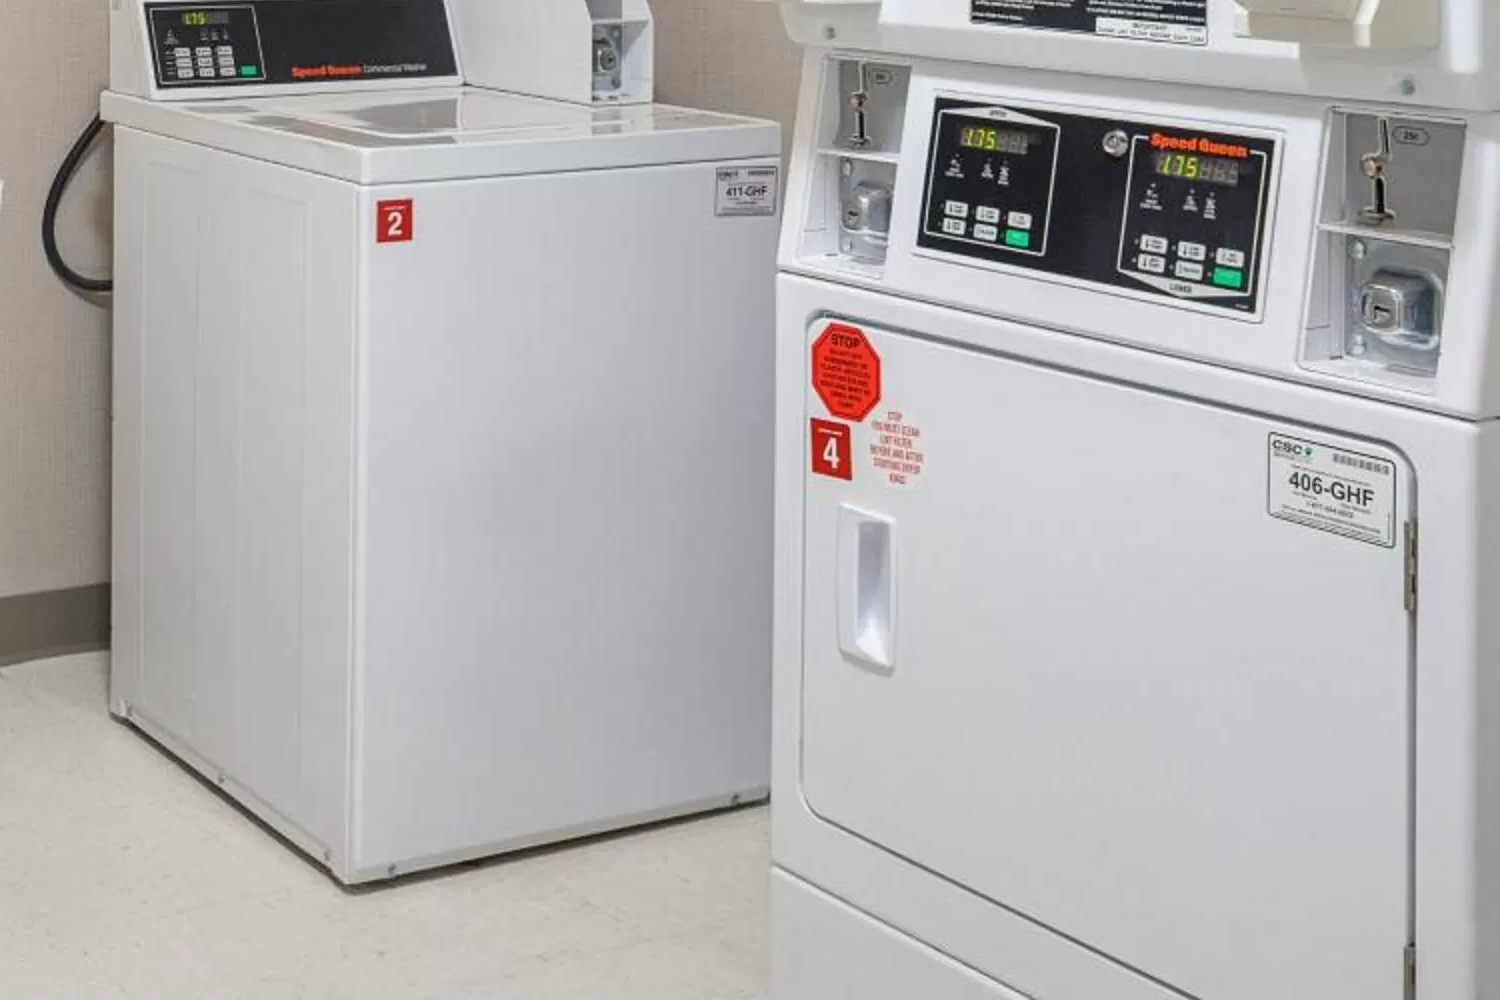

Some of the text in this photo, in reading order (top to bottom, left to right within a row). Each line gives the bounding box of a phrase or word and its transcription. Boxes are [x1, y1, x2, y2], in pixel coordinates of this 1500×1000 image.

[1151, 132, 1248, 158] Speed Queen
[725, 185, 768, 197] 411-GHF
[387, 211, 403, 236] 2
[831, 333, 861, 349] STOP
[823, 437, 840, 469] 4
[1272, 439, 1303, 455] CSC
[1288, 472, 1375, 507] 406-GHF
